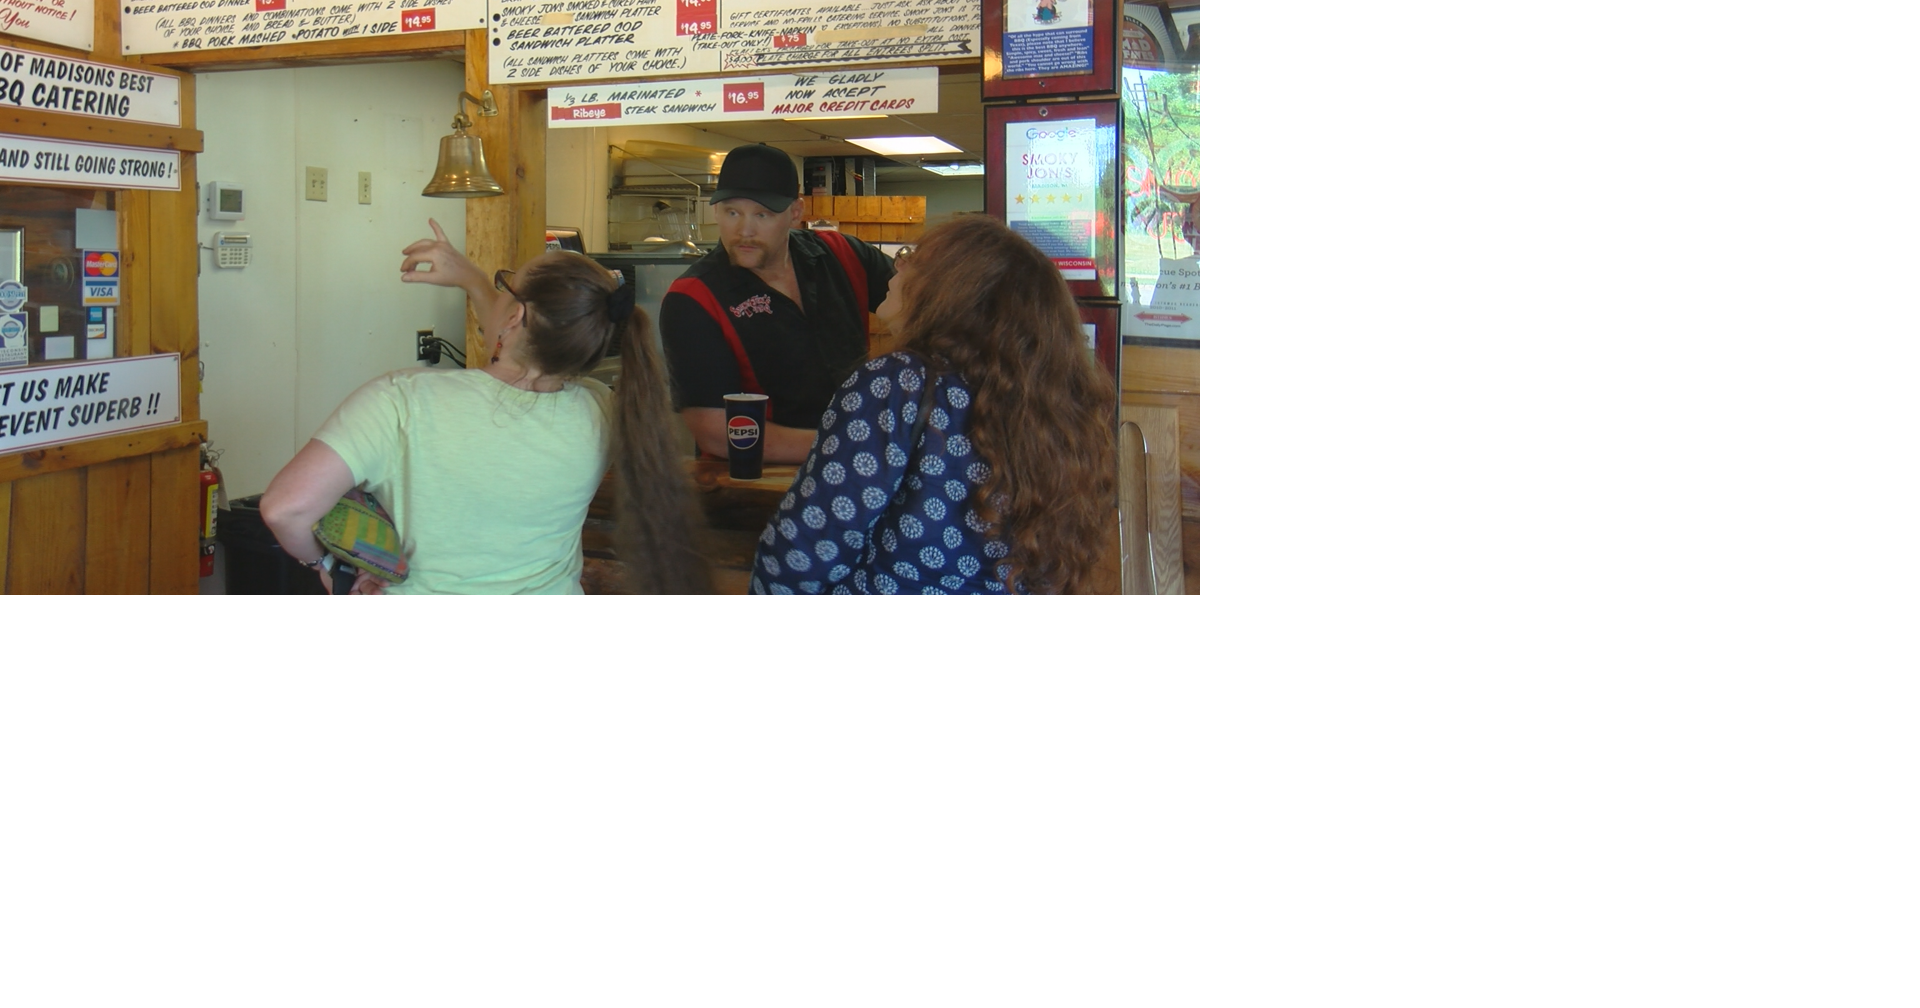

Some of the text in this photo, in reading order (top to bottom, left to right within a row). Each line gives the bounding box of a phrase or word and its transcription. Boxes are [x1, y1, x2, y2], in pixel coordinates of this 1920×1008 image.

[133, 5, 155, 15] BEER
[157, 2, 198, 13] BATTERED
[200, 0, 215, 9] COD
[155, 17, 174, 31] (ALL
[178, 17, 196, 27] BBQ
[200, 14, 236, 25] DINNERS
[242, 12, 259, 22] AND
[263, 6, 326, 20] COMBINATIONS
[330, 4, 353, 14] COME
[357, 2, 382, 12] WITH
[386, 0, 395, 9] 2
[400, 0, 418, 8] SIDE
[502, 5, 536, 17] SMOKY
[566, 0, 600, 11] SMOKED
[509, 15, 543, 26] CHEESE
[575, 9, 618, 21] SANDWICH
[620, 5, 661, 18] PLATTER
[730, 11, 751, 20] GIFT
[753, 8, 811, 19] CERTIFICATES
[816, 3, 861, 14] AVAILABLE
[871, 1, 896, 10] JUST
[826, 13, 866, 22] CATERING
[903, 8, 930, 17] SMOKY
[0, 7, 30, 31] You
[405, 15, 431, 29] $14.95
[887, 19, 901, 27] NO
[164, 28, 176, 38] OF
[179, 27, 202, 37] YOUR
[242, 22, 260, 32] AND
[264, 19, 294, 31] BREAD
[182, 37, 202, 49] BBQ
[207, 35, 236, 47] PORK
[238, 30, 286, 45] MASHED
[296, 26, 340, 40] POTATO
[362, 24, 369, 34] 1
[370, 21, 398, 34] SIDE
[507, 20, 643, 40] BEER BATTERED COD
[681, 21, 712, 34] $14.95
[927, 25, 944, 33] ALL
[510, 33, 635, 51] SANDWICH PLATTER
[914, 35, 943, 43] EXTRA
[503, 47, 683, 68] (ALL SANDWICH PLATTERS COME WITH
[821, 50, 839, 58] FOR
[841, 48, 860, 57] ALL
[866, 45, 913, 56] ENTREES
[1, 51, 154, 93] OF MADISONS BEST
[507, 69, 517, 78] 2
[521, 67, 542, 77] SIDE
[549, 64, 582, 76] DISHES
[588, 63, 602, 74] OF
[609, 60, 638, 72] YOUR
[794, 72, 884, 87] WE GLADLY
[32, 82, 130, 117] CATERING
[581, 92, 599, 103] LB.
[607, 88, 686, 102] MARINATED
[728, 91, 759, 105] $16.95
[785, 85, 886, 100] NOW ACCEPT
[572, 102, 717, 119] Ribeye STEAK SANDWICH
[771, 98, 915, 115] MAJOR CREDIT CARDS
[1026, 127, 1077, 141] Google
[0, 148, 29, 168] AND
[34, 151, 70, 171] STILL
[75, 154, 116, 175] GOING
[1022, 152, 1078, 166] SMOKY
[86, 260, 117, 268] MasterCard
[1178, 268, 1200, 278] Spot
[90, 286, 114, 297] VISA
[20, 378, 49, 403] US
[54, 372, 110, 399] MAKE
[0, 406, 64, 438] EVENT
[68, 396, 142, 427] SUPERB
[729, 427, 758, 436] PEPSI
